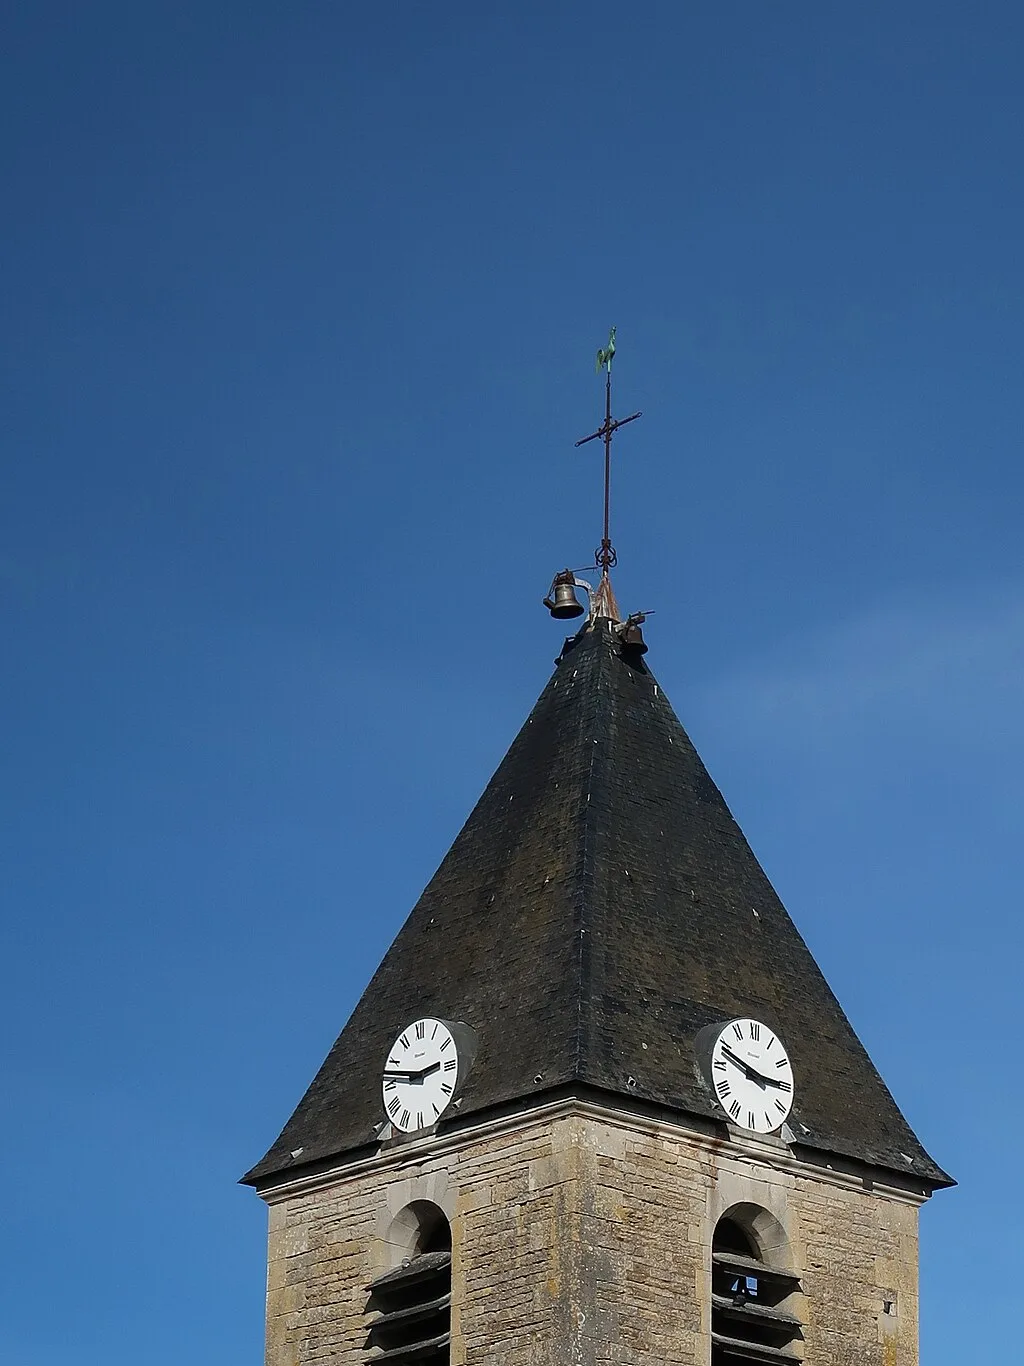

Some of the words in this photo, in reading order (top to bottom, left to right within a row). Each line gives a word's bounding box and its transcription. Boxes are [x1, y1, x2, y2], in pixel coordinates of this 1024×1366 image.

[415, 1022, 424, 1040] XII
[431, 1024, 438, 1040] I
[732, 1024, 743, 1042] XI
[750, 1022, 760, 1041] XII
[400, 1034, 410, 1052] XI
[440, 1037, 451, 1052] II
[767, 1037, 774, 1050] I
[444, 1060, 456, 1072] III
[776, 1059, 787, 1068] II
